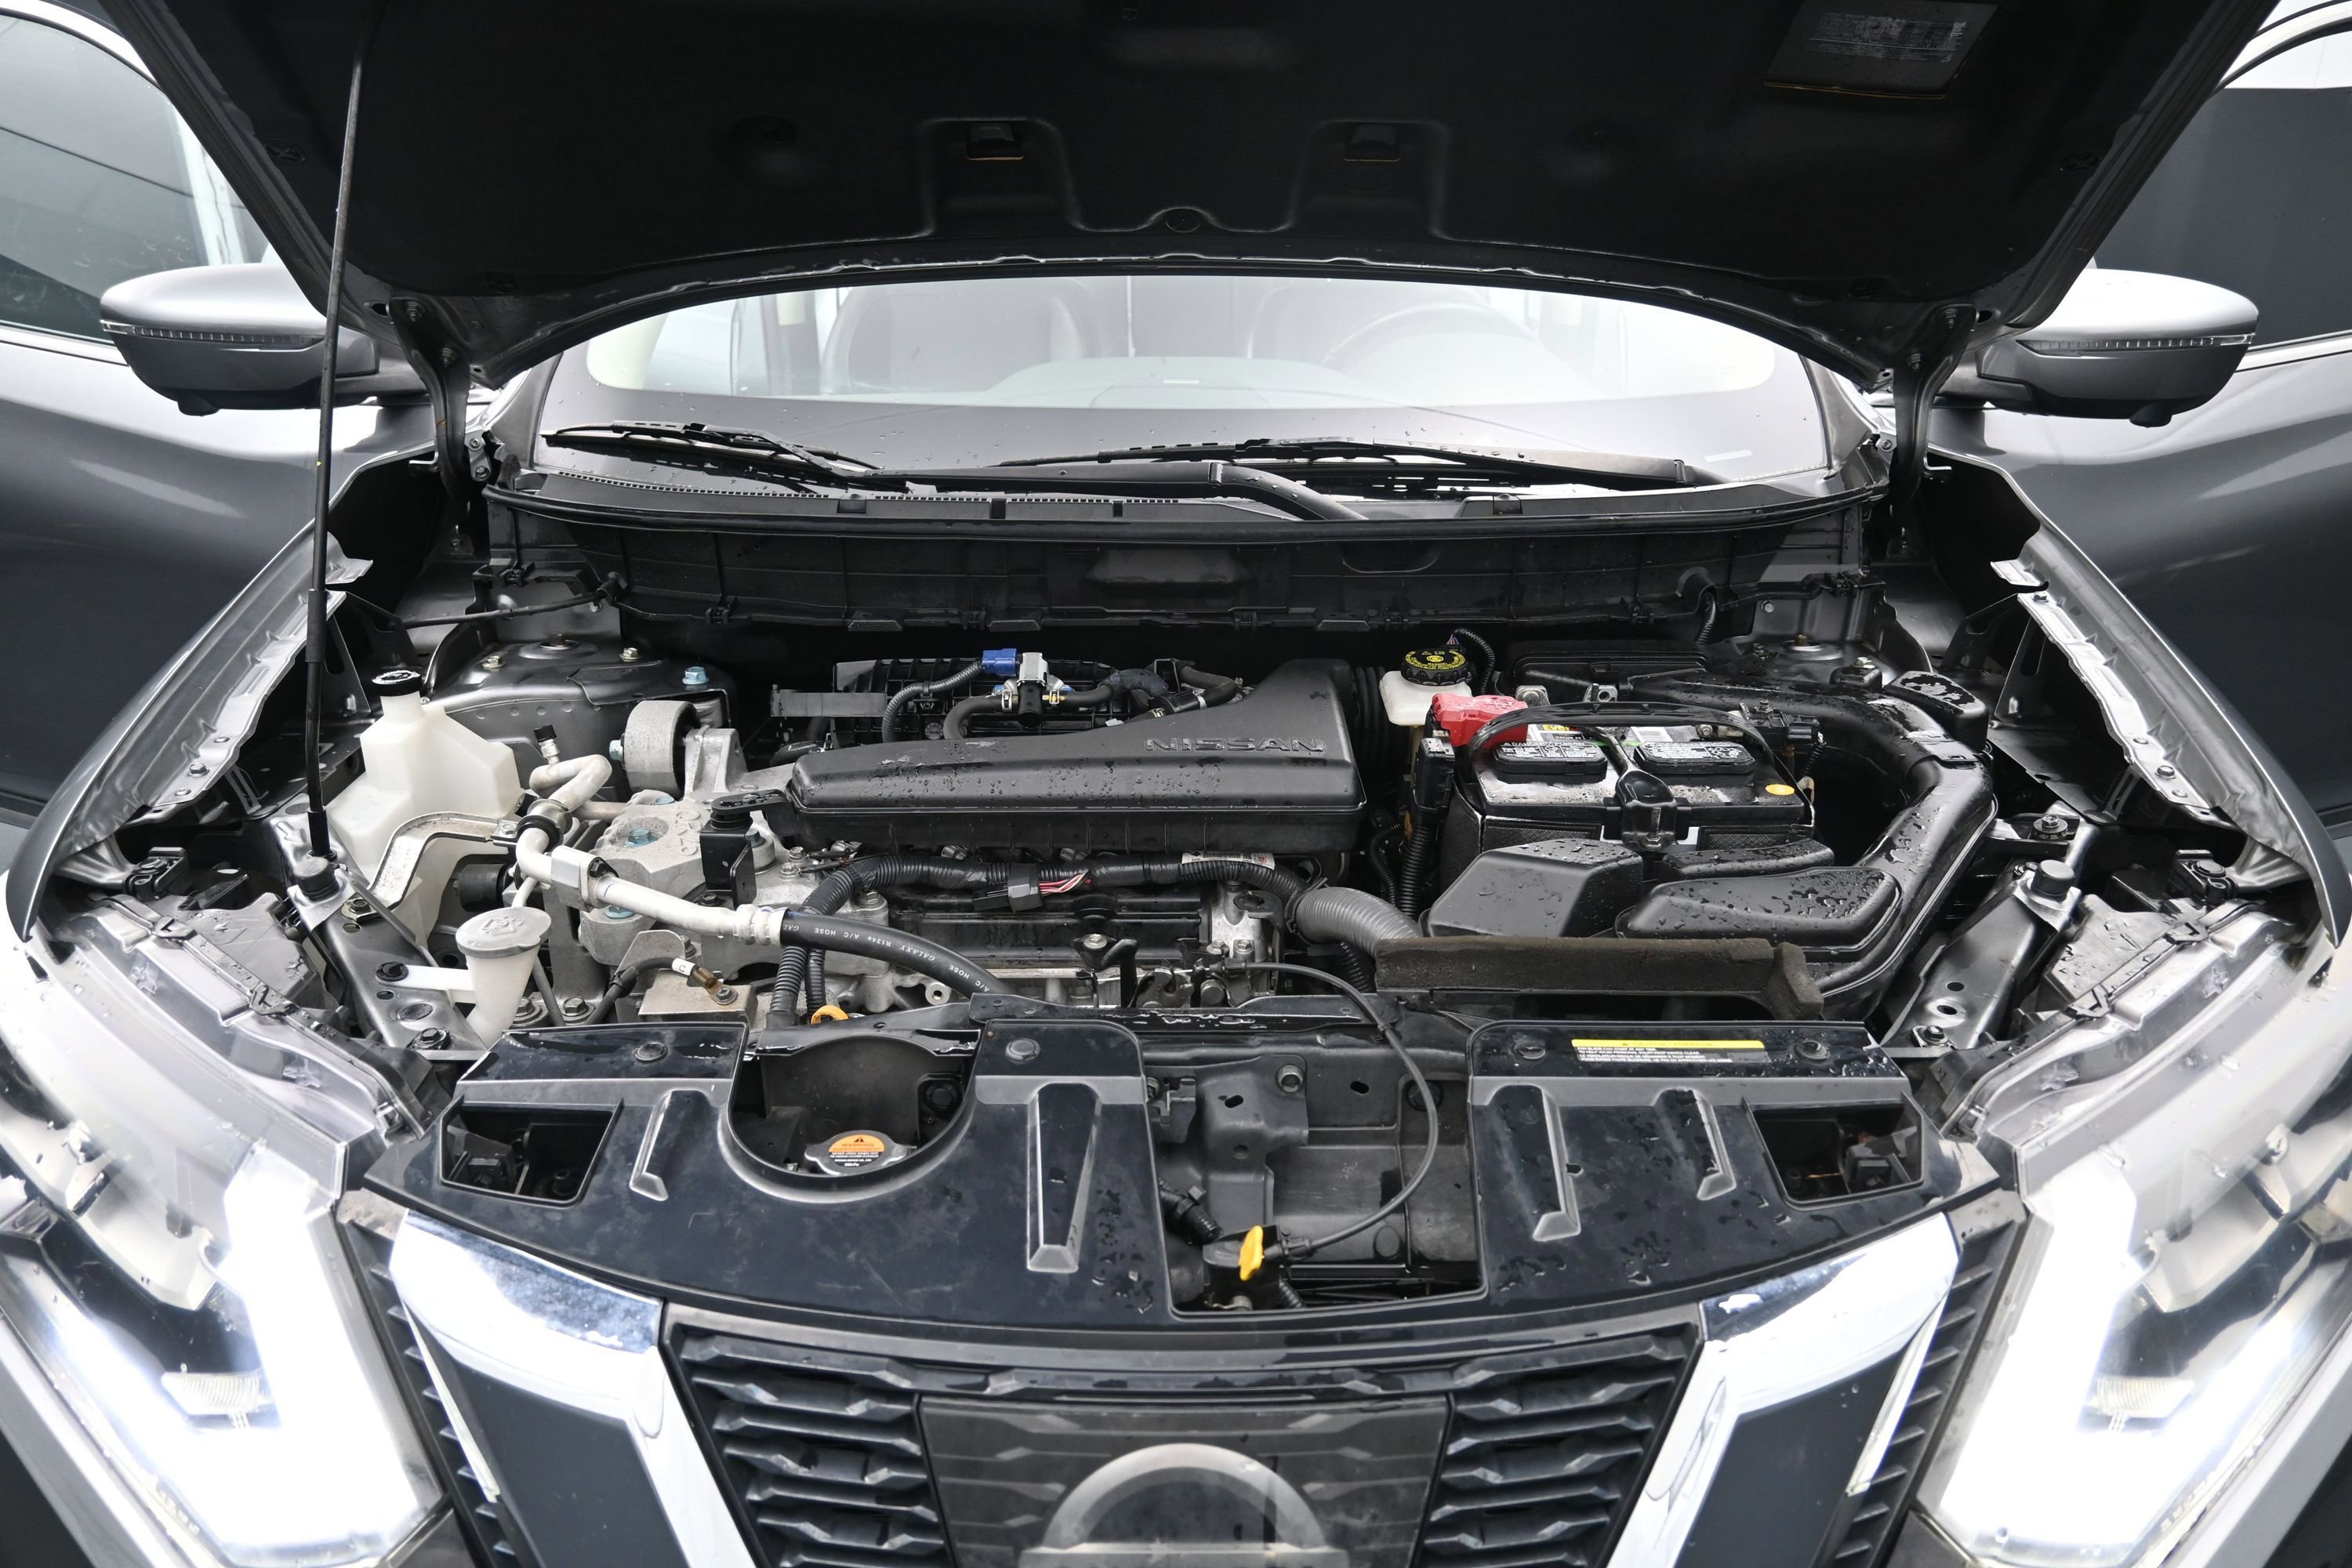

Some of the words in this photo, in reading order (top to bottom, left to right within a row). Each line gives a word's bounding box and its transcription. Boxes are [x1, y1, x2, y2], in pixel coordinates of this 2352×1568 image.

[1145, 738, 1325, 753] NISSAN
[867, 936, 891, 946] R134a
[898, 945, 935, 961] GALAXY
[679, 964, 686, 973] C
[949, 964, 971, 979] HOSE
[975, 980, 989, 993] A/C
